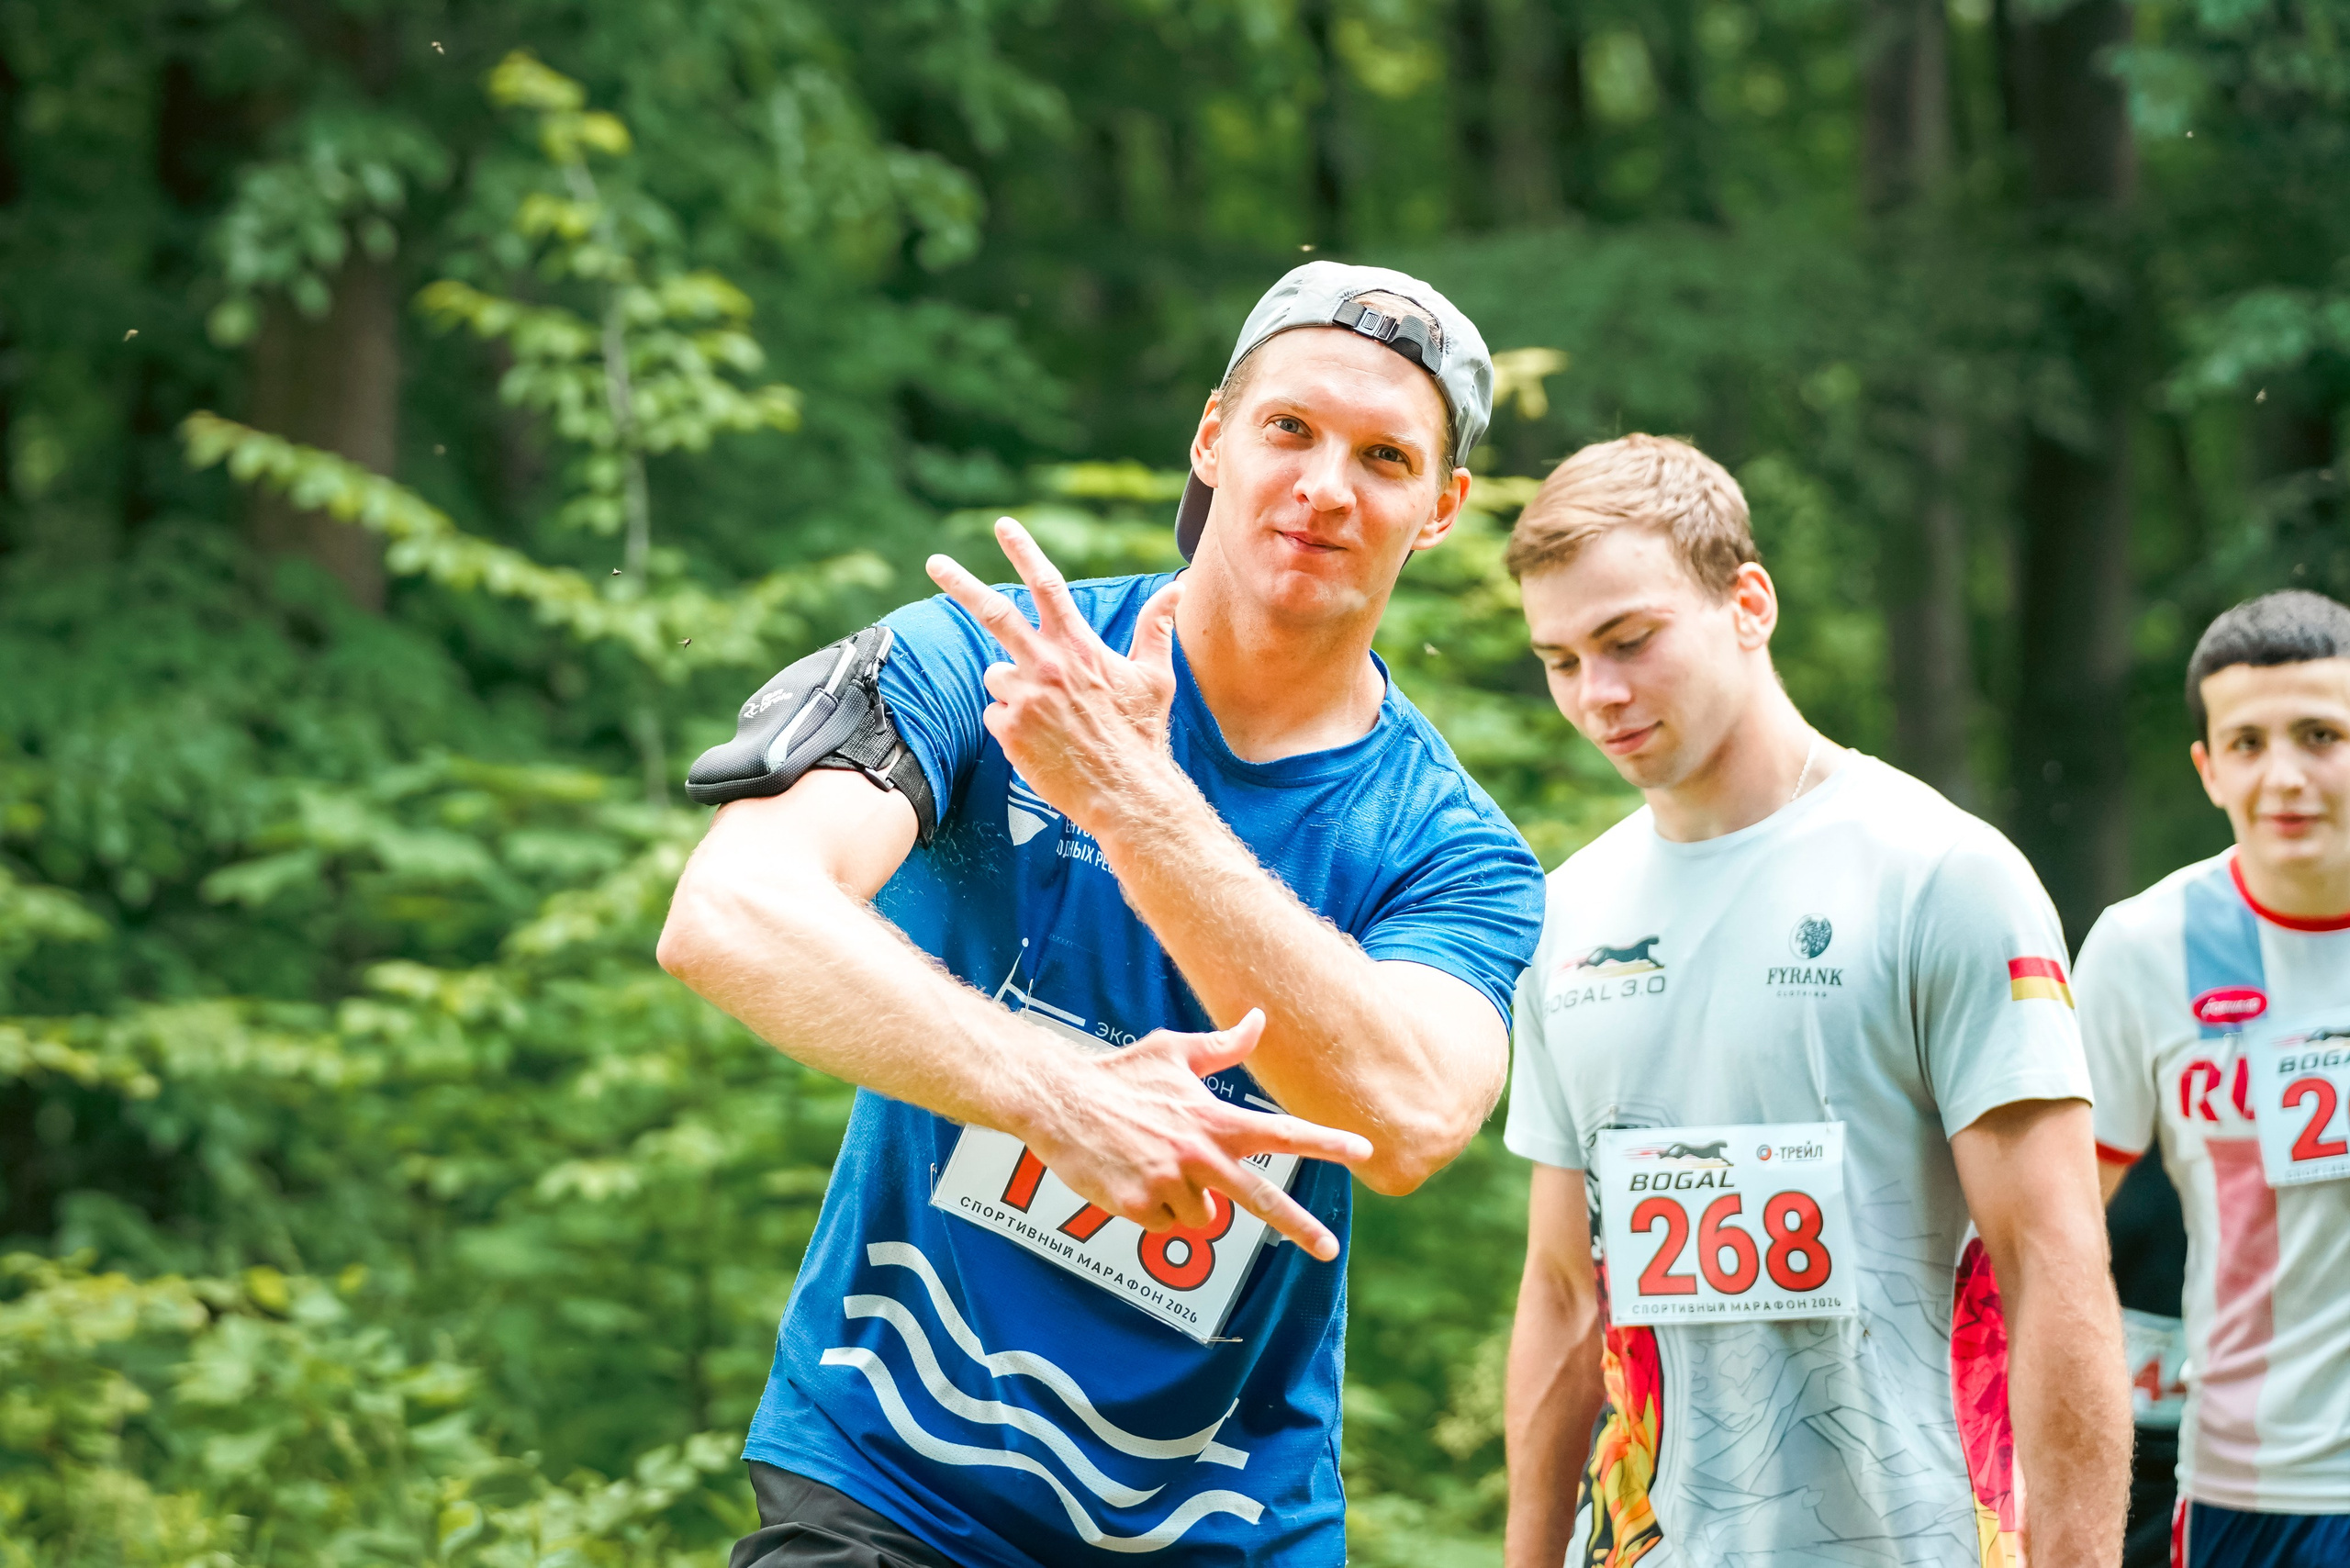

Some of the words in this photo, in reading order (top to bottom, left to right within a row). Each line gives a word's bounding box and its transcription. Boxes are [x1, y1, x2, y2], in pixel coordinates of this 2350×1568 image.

[1621, 975, 1666, 997] 3.0
[1766, 967, 1843, 986] FYRANK
[1203, 1076, 1235, 1098] ОН
[2281, 1077, 2350, 1161] 2
[1629, 1170, 1735, 1192] BOGAL
[1630, 1191, 1832, 1296] 268
[960, 1195, 1074, 1260] СПОРТИВНЫЙ
[1077, 1252, 1163, 1305] МАРАФОН
[1166, 1297, 1198, 1324] 2026
[1632, 1301, 1726, 1315] СПОРТИВНЫЙ
[1730, 1298, 1807, 1312] МАРАФОН
[1811, 1296, 1841, 1308] 2026
